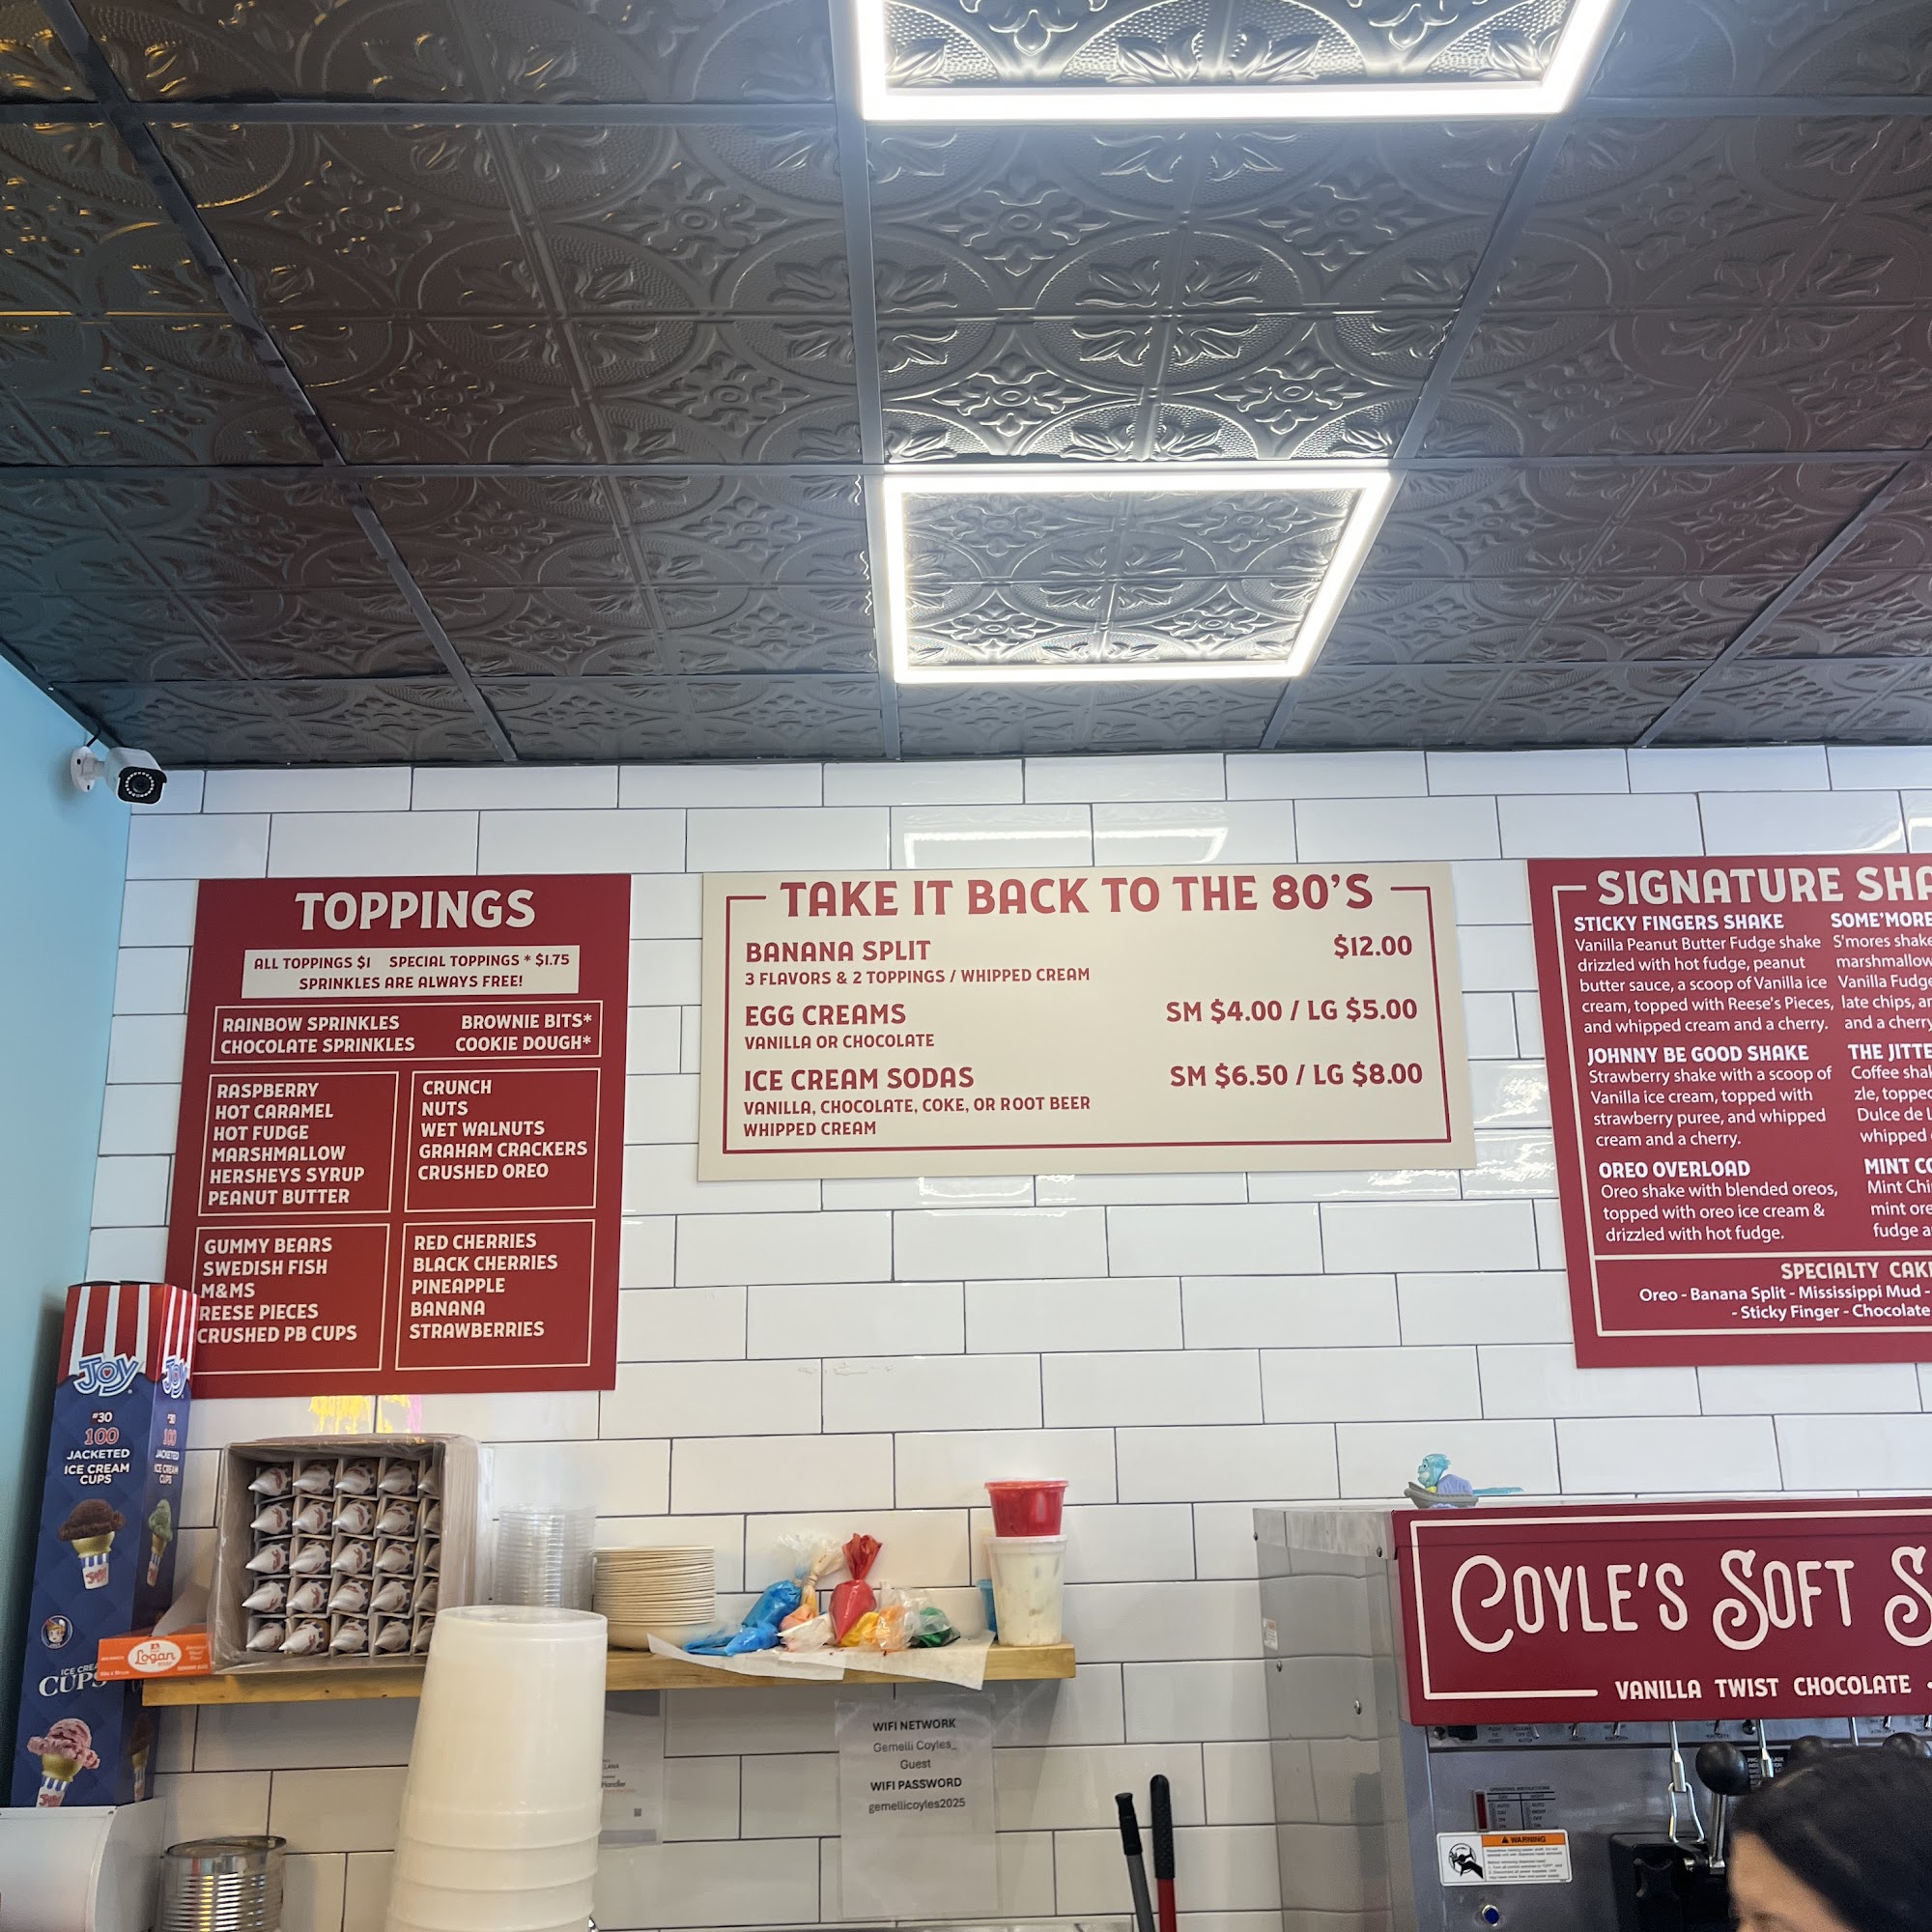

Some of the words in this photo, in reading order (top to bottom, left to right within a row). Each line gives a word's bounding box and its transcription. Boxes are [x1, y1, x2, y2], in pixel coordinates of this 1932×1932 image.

[1598, 867, 1843, 904] SIGNATURE
[780, 881, 897, 917] TAKE
[914, 881, 952, 915] IT
[968, 878, 1089, 914] BACK
[1101, 877, 1159, 912] TO
[1173, 875, 1258, 911] THE
[1273, 873, 1372, 910] 80'S
[296, 890, 535, 929] TOPPINGS
[1575, 916, 1636, 931] STICKY
[1642, 915, 1719, 930] FINGERS
[1723, 914, 1784, 929] SHAKE
[747, 942, 853, 962] BANANA
[863, 941, 930, 960] SPLIT
[1334, 934, 1411, 958] $12.00
[1576, 938, 1623, 951] Vanilla
[1628, 938, 1678, 951] Peanut
[1682, 937, 1726, 950] Butter
[1730, 936, 1776, 952] Fudge
[1779, 935, 1821, 949] shake
[255, 958, 278, 969] ALL
[283, 957, 352, 969] TOPPINGS
[357, 955, 370, 969] $1
[390, 956, 445, 967] SPECIAL
[450, 955, 519, 966] TOPPINGS
[536, 953, 569, 966] $1.75
[1578, 958, 1634, 972] drizzled
[1638, 957, 1670, 971] with
[1675, 957, 1700, 970] hot
[1703, 956, 1749, 973] fudge,
[1753, 956, 1805, 972] peanut
[299, 978, 380, 989] SPRINKLES
[385, 978, 413, 988] ARE
[418, 976, 477, 987] ALWAYS
[483, 976, 522, 986] FREE!
[746, 973, 754, 985] 3
[760, 972, 831, 985] FLAVORS
[853, 972, 862, 983] 2
[867, 970, 945, 983] TOPPINGS
[961, 969, 1031, 981] WHIPPED
[1037, 968, 1089, 980] CREAM
[746, 1006, 794, 1026] EGG
[803, 1004, 905, 1025] CREAMS
[1167, 1002, 1202, 1022] SM
[1211, 999, 1282, 1024] $4.00
[1308, 1000, 1337, 1020] LG
[1347, 997, 1417, 1022] $5.00
[223, 1017, 302, 1032] RAINBOW
[307, 1016, 399, 1031] SPRINKLES
[221, 1039, 317, 1054] CHOCOLATE
[323, 1037, 414, 1052] SPRINKLES
[745, 1036, 810, 1049] VANILLA
[817, 1036, 838, 1048] OR
[843, 1034, 934, 1047] CHOCOLATE
[1588, 1047, 1658, 1066] JOHNNY
[1663, 1047, 1687, 1063] BE
[1691, 1046, 1742, 1062] GOOD
[1747, 1045, 1808, 1061] SHAKE
[745, 1070, 782, 1091] ICE
[791, 1068, 877, 1090] CREAM
[887, 1067, 974, 1089] SODAS
[1171, 1066, 1206, 1086] SM
[1215, 1063, 1287, 1089] $6.50
[1314, 1065, 1343, 1084] LG
[1352, 1062, 1422, 1087] $8.00
[217, 1083, 319, 1098] RASPBERRY
[423, 1080, 492, 1094] CRUNCH
[1591, 1090, 1639, 1104] Vanilla
[1644, 1091, 1664, 1103] ice
[1669, 1093, 1718, 1104] cream,
[1721, 1088, 1776, 1105] topped
[1779, 1087, 1812, 1101] with
[215, 1105, 250, 1120] HOT
[255, 1103, 333, 1119] CARAMEL
[744, 1101, 815, 1115] VANILLA,
[821, 1099, 918, 1113] CHOCOLATE,
[923, 1098, 968, 1113] COKE,
[974, 1098, 995, 1111] OR
[1001, 1097, 1044, 1110] ROOT
[1050, 1096, 1090, 1109] BEER
[421, 1122, 458, 1137] WET
[463, 1121, 545, 1136] WALNUTS
[213, 1146, 346, 1162] MARSHMALLOW
[419, 1143, 493, 1158] GRAHAM
[497, 1141, 587, 1157] CRACKERS
[210, 1168, 300, 1183] HERSHEYS
[306, 1167, 364, 1182] SYRUP
[418, 1165, 497, 1179] CRUSHED
[502, 1163, 549, 1179] OREO
[1600, 1162, 1648, 1179] OREO
[1653, 1161, 1750, 1177] OVERLOAD
[1602, 1184, 1638, 1198] Oreo
[1642, 1183, 1685, 1198] shake
[1689, 1182, 1721, 1197] with
[1725, 1181, 1788, 1196] blended
[1793, 1184, 1837, 1197] oreos,
[205, 1238, 270, 1254] GUMMY
[274, 1237, 332, 1253] BEARS
[414, 1236, 448, 1250] RED
[453, 1233, 536, 1249] CHERRIES
[203, 1261, 283, 1276] SWEDISH
[288, 1260, 327, 1274] FISH
[1781, 1263, 1879, 1279] SPECIALTY
[201, 1283, 255, 1298] M&MS
[200, 1305, 254, 1321] REESE
[259, 1304, 318, 1320] PIECES
[411, 1300, 485, 1317] BANANA
[198, 1327, 279, 1343] CRUSHED
[284, 1326, 306, 1341] PB
[312, 1325, 356, 1341] CUPS
[410, 1321, 544, 1339] STRAWBERRIES
[92, 1411, 113, 1423] #30
[84, 1427, 119, 1446] 100
[163, 1429, 177, 1446] 100
[67, 1449, 129, 1460] JACKETED
[156, 1450, 180, 1461] JACKETED
[64, 1464, 84, 1475] ICE
[87, 1463, 129, 1474] CREAM
[79, 1474, 112, 1485] CUPS
[1452, 1555, 1688, 1652] COYLE'S
[1713, 1549, 1854, 1650] SOFT
[135, 1650, 176, 1665] Logan
[77, 1663, 98, 1673] CRE
[1615, 1680, 1702, 1699] VANILLA
[1715, 1678, 1778, 1697] TWIST
[1794, 1675, 1911, 1695] CHOCOLATE
[872, 1721, 897, 1731] WIFI
[899, 1719, 956, 1729] NETWORK
[872, 1742, 914, 1752] Gemelli
[899, 1760, 931, 1770] Guest
[870, 1781, 895, 1791] WIFI
[897, 1777, 962, 1789] PASSWORD
[868, 1798, 966, 1814] gemellicoyles2025
